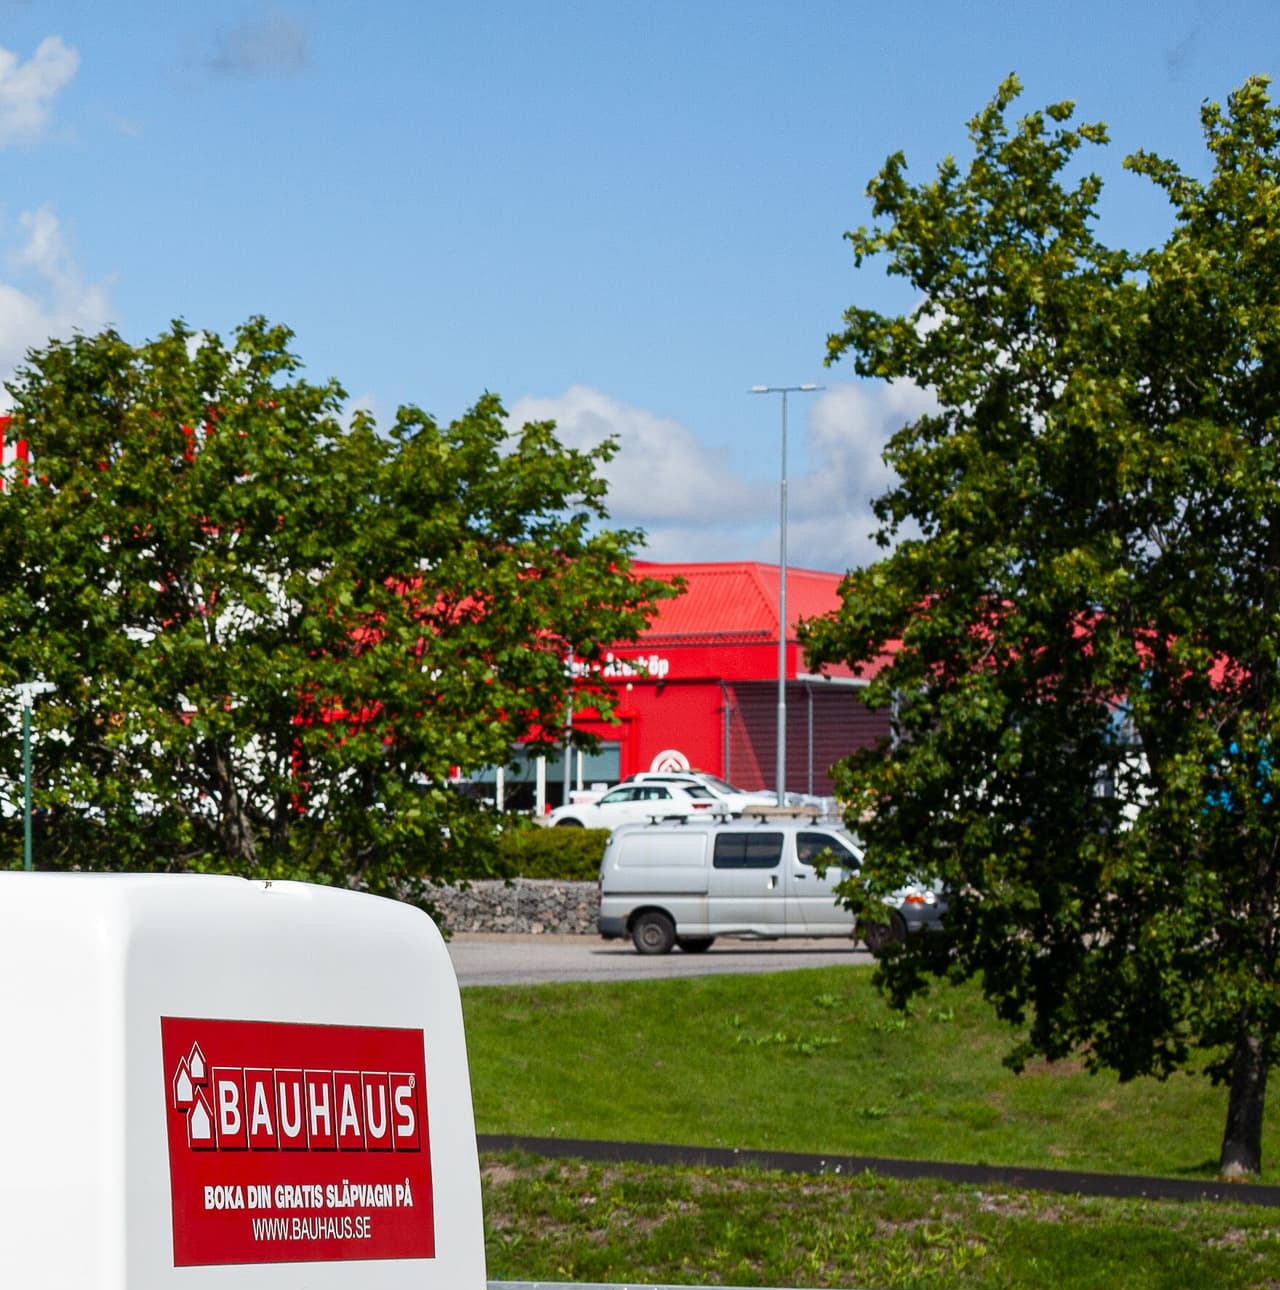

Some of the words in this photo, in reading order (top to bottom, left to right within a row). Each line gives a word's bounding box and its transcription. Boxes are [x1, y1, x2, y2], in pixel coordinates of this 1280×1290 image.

[218, 1080, 416, 1139] BAUHAUS
[204, 1185, 245, 1210] BOKA
[248, 1184, 272, 1209] DIN
[274, 1183, 323, 1209] GRATIS
[326, 1180, 393, 1209] SLÄPVAGN
[396, 1177, 414, 1207] PÅ
[252, 1216, 372, 1241] WWW.BAUHAUS.SE
